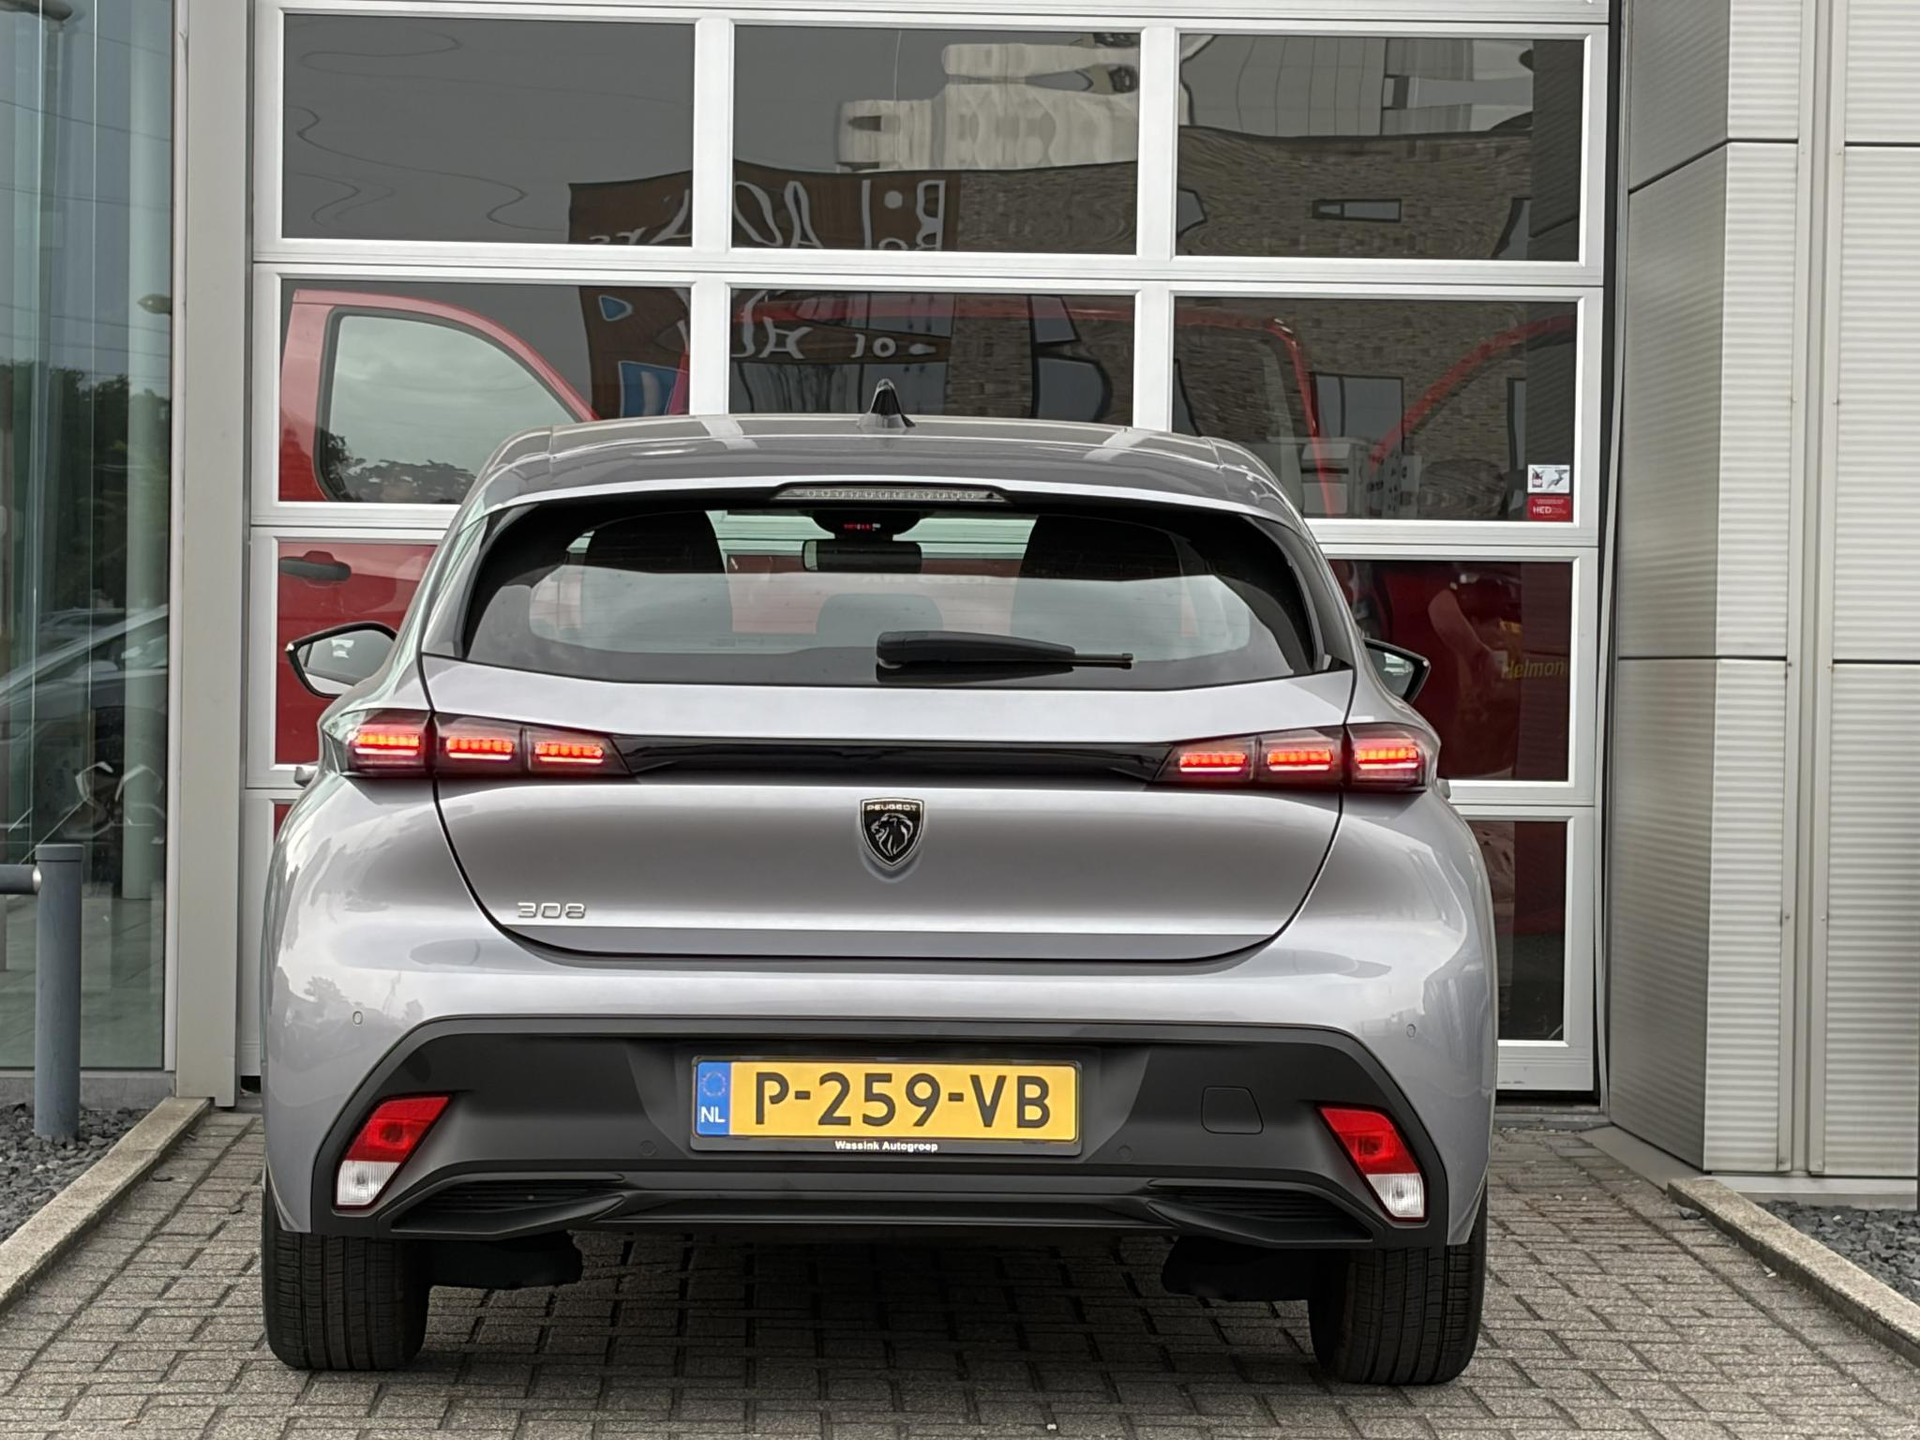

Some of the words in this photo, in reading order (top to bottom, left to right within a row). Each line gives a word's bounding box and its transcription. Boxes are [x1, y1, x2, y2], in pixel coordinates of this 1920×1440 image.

[866, 803, 918, 812] PEUGEOT
[517, 902, 586, 919] 308
[754, 1071, 1051, 1129] P-259-VB
[700, 1106, 726, 1123] NL
[834, 1140, 880, 1150] Wassink
[882, 1141, 939, 1153] Autogroep
